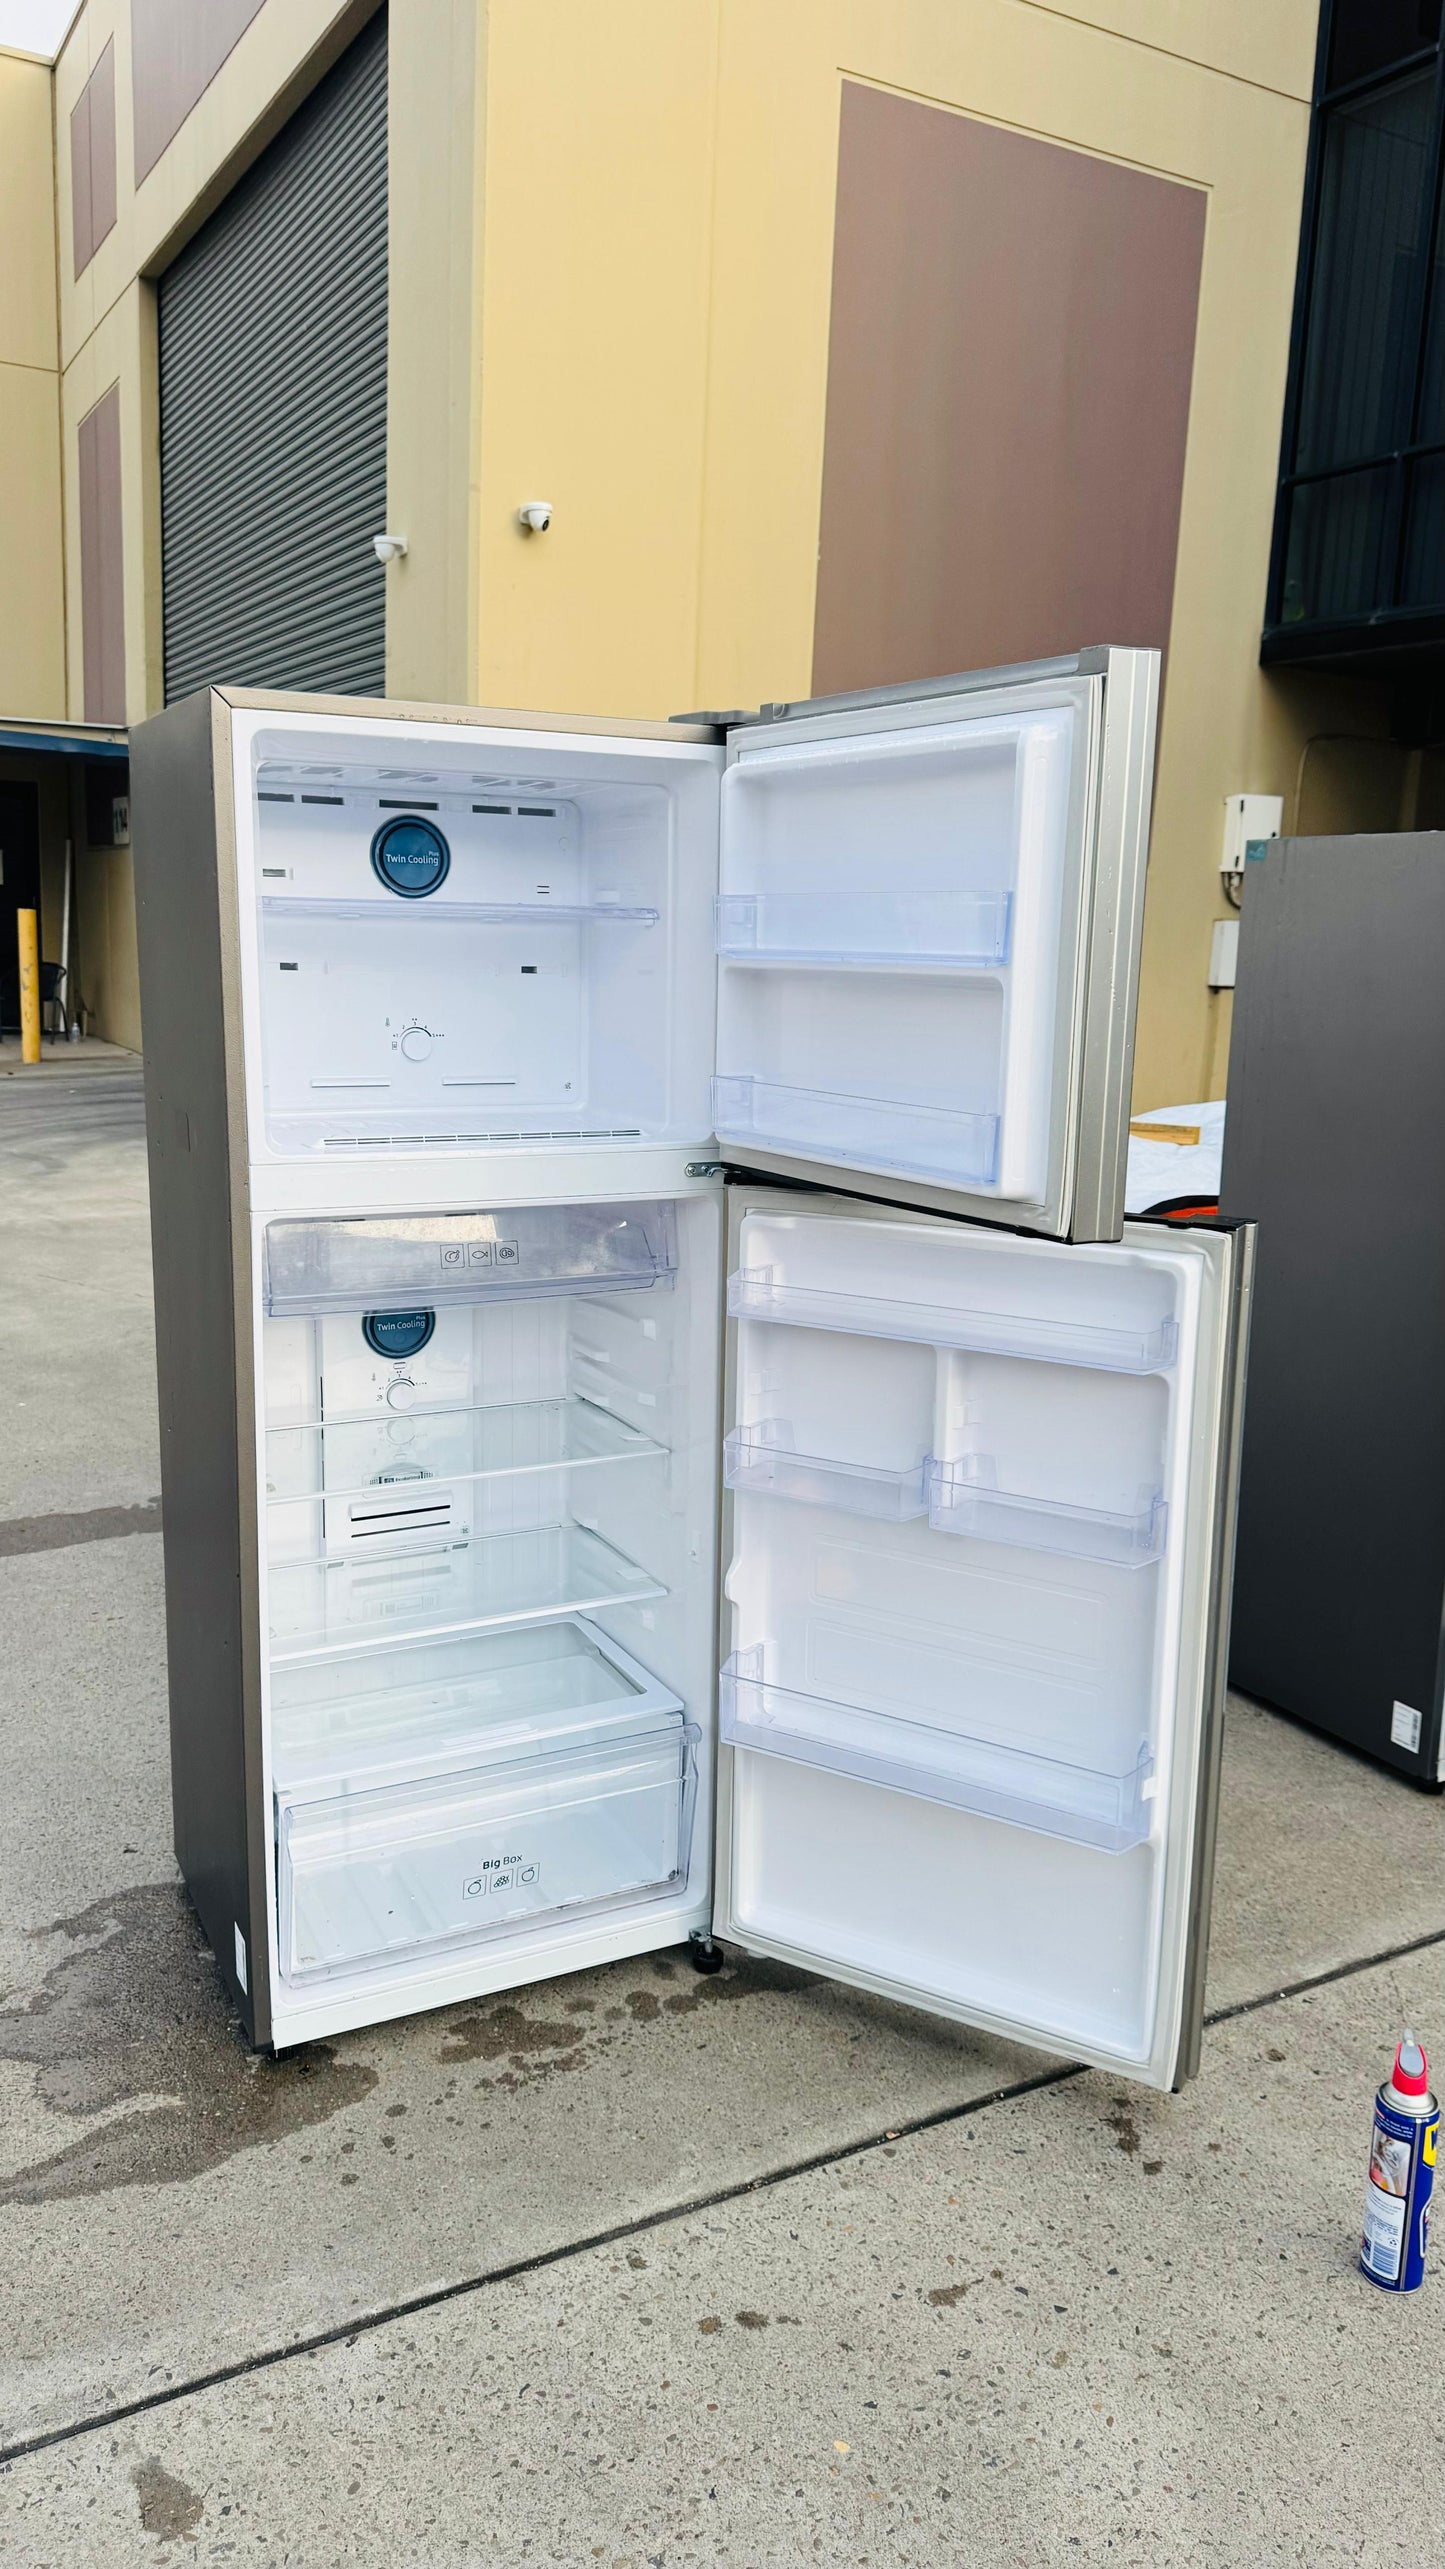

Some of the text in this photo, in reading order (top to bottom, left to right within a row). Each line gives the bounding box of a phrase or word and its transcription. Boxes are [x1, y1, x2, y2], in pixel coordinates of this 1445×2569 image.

[386, 854, 439, 866] Twin Cooling
[377, 1319, 426, 1331] Twin Cooling
[482, 1854, 523, 1870] Big Box
